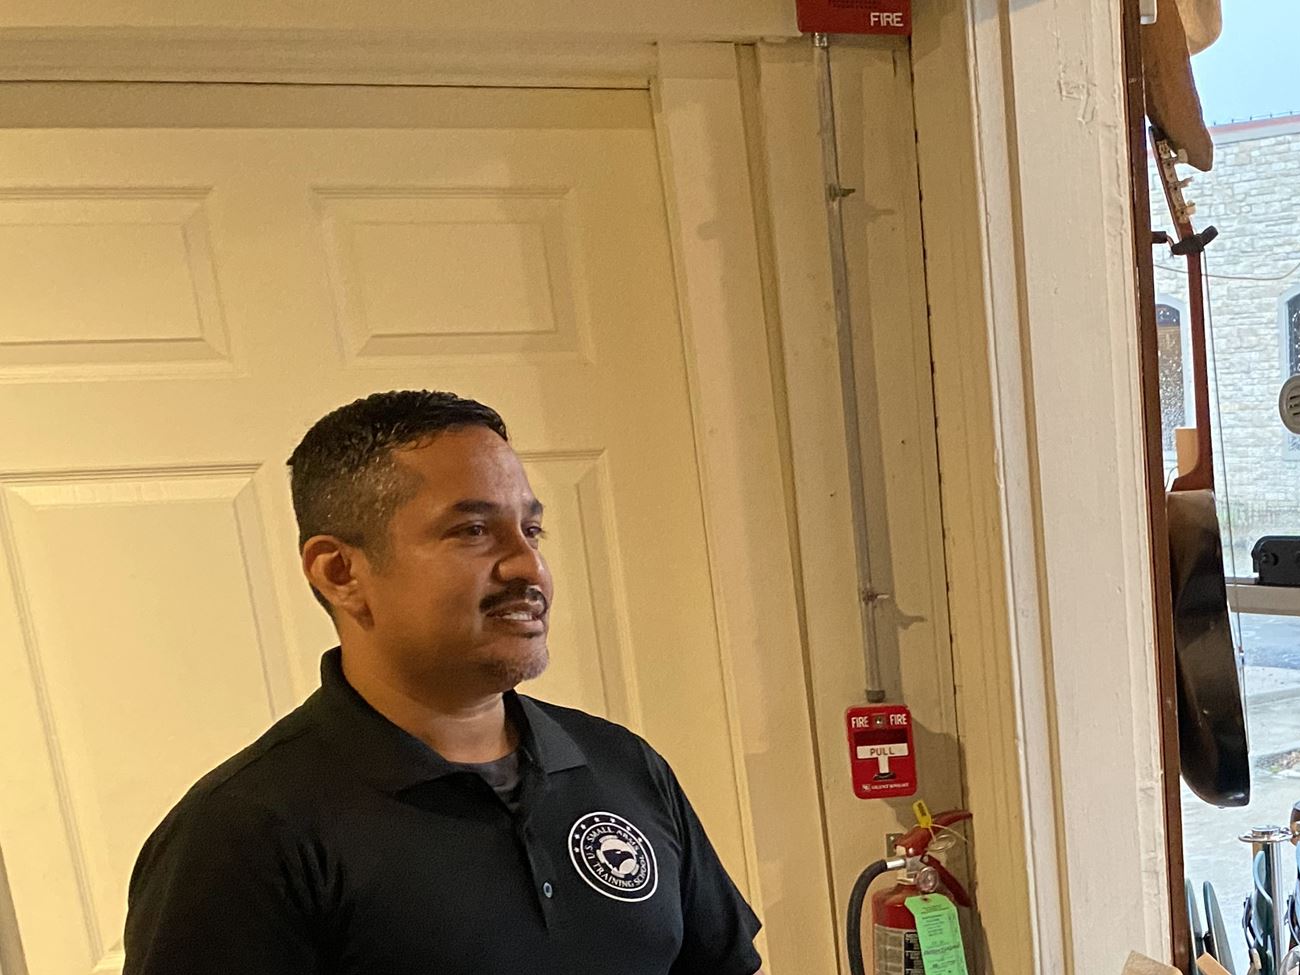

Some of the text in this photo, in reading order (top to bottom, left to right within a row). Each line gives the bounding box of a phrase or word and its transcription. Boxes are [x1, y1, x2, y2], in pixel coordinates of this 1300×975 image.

[870, 12, 904, 27] FIRE
[851, 713, 908, 728] FIRE FIRE
[869, 747, 895, 756] PULL
[586, 826, 615, 843] SMALL
[592, 862, 635, 888] TRAINING
